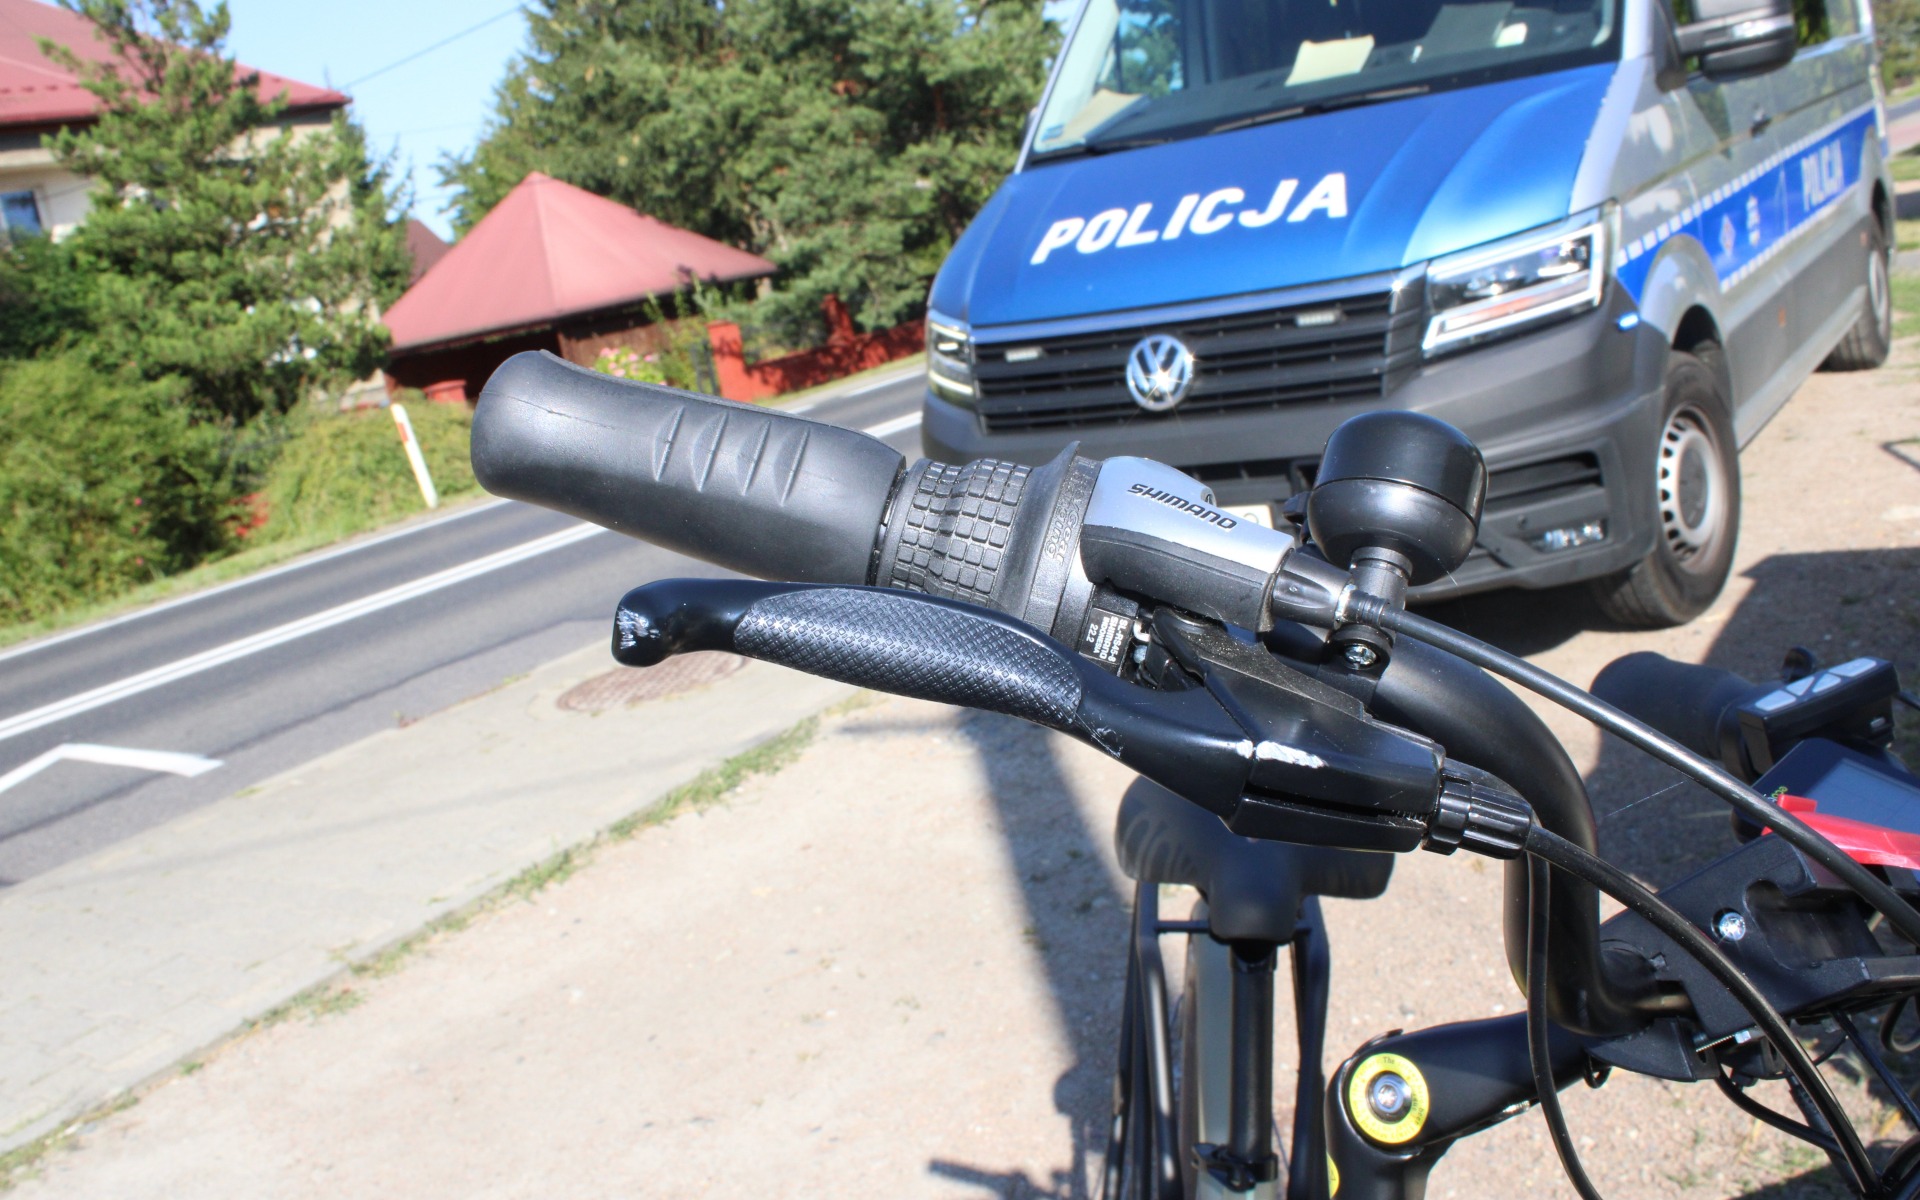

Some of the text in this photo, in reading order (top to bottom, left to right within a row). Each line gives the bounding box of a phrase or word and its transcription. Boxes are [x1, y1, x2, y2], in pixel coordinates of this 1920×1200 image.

[1030, 172, 1348, 265] POLICJA
[1127, 483, 1238, 530] SHIMANO
[1086, 623, 1099, 643] 22.2
[1093, 616, 1110, 654] INDONESIA
[1099, 616, 1119, 660] SHIMANO
[1107, 618, 1128, 662] SL-RS45-8
